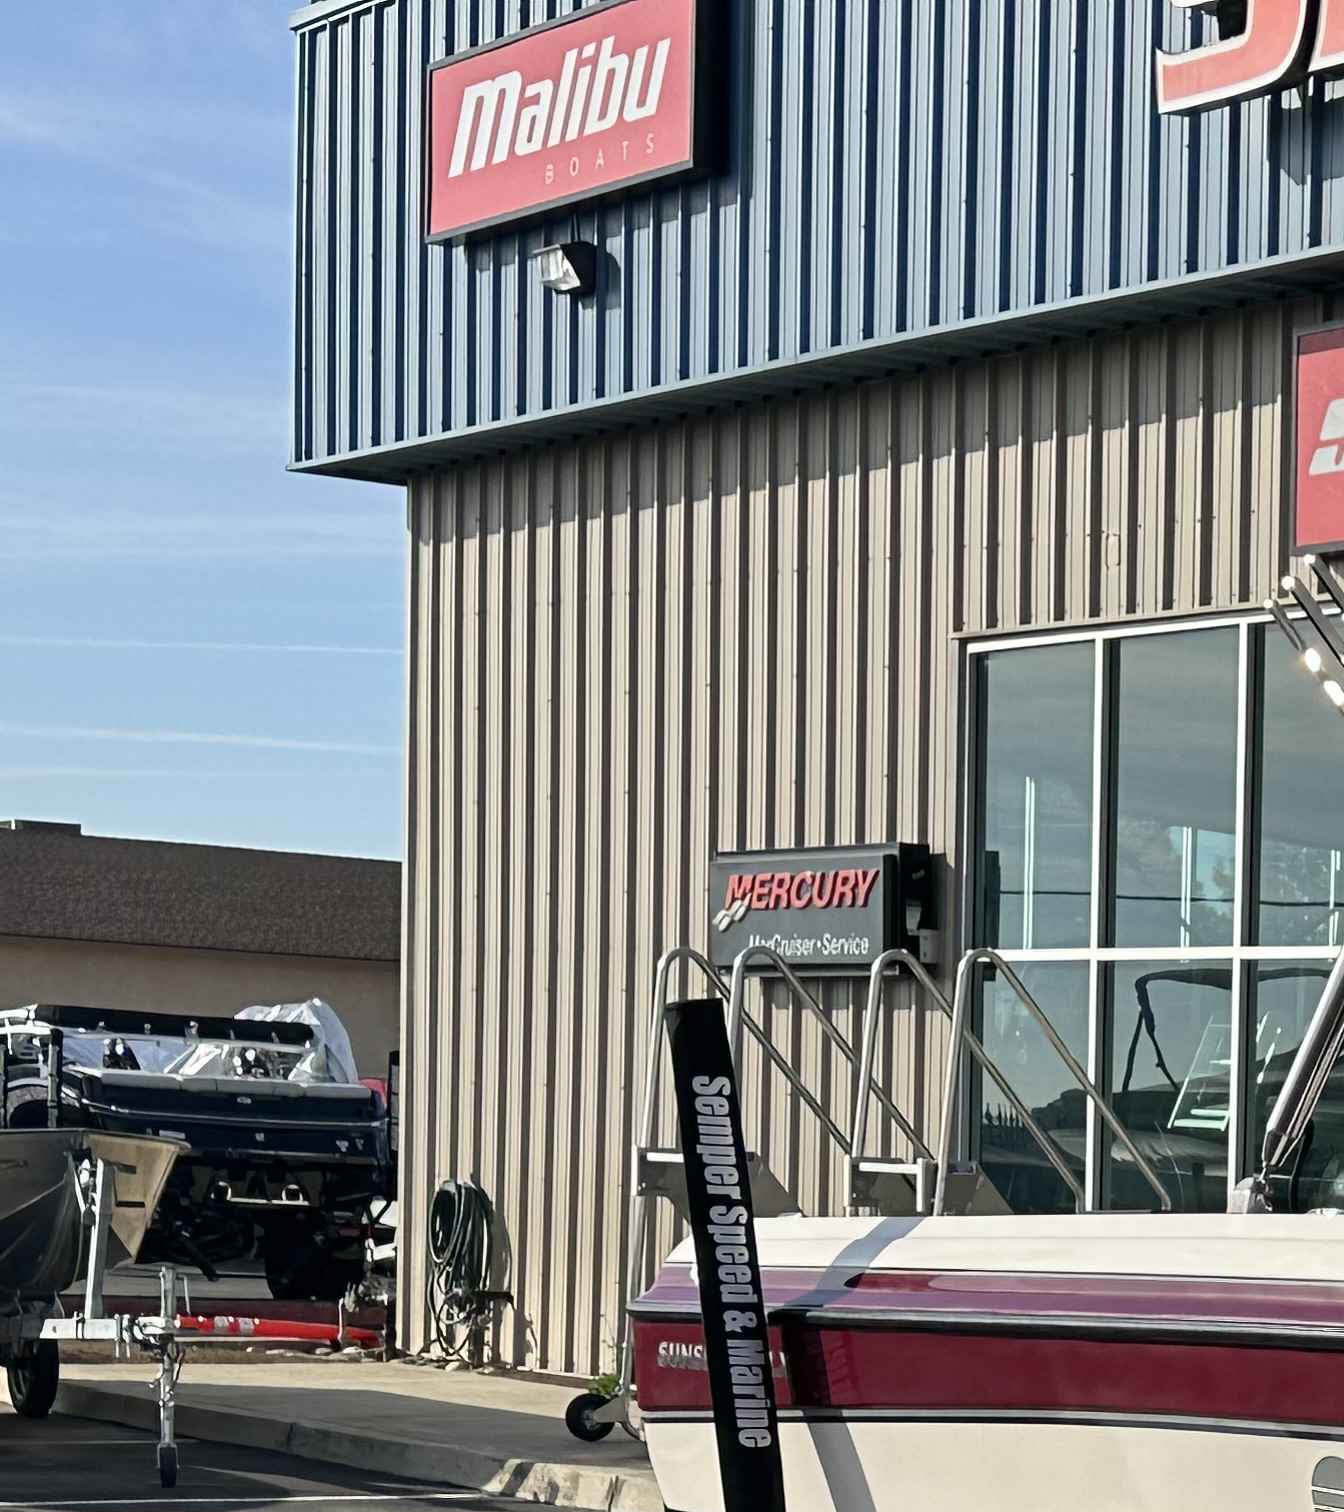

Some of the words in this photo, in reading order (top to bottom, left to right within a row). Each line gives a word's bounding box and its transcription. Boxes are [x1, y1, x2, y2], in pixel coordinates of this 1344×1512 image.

[447, 34, 671, 178] Malibu
[545, 132, 655, 184] BOATS
[725, 868, 881, 911] MERCURY
[822, 931, 869, 956] Service
[692, 1075, 742, 1200] Semper
[707, 1205, 759, 1303] Speed
[723, 1310, 758, 1333] &
[727, 1339, 772, 1448] Marine
